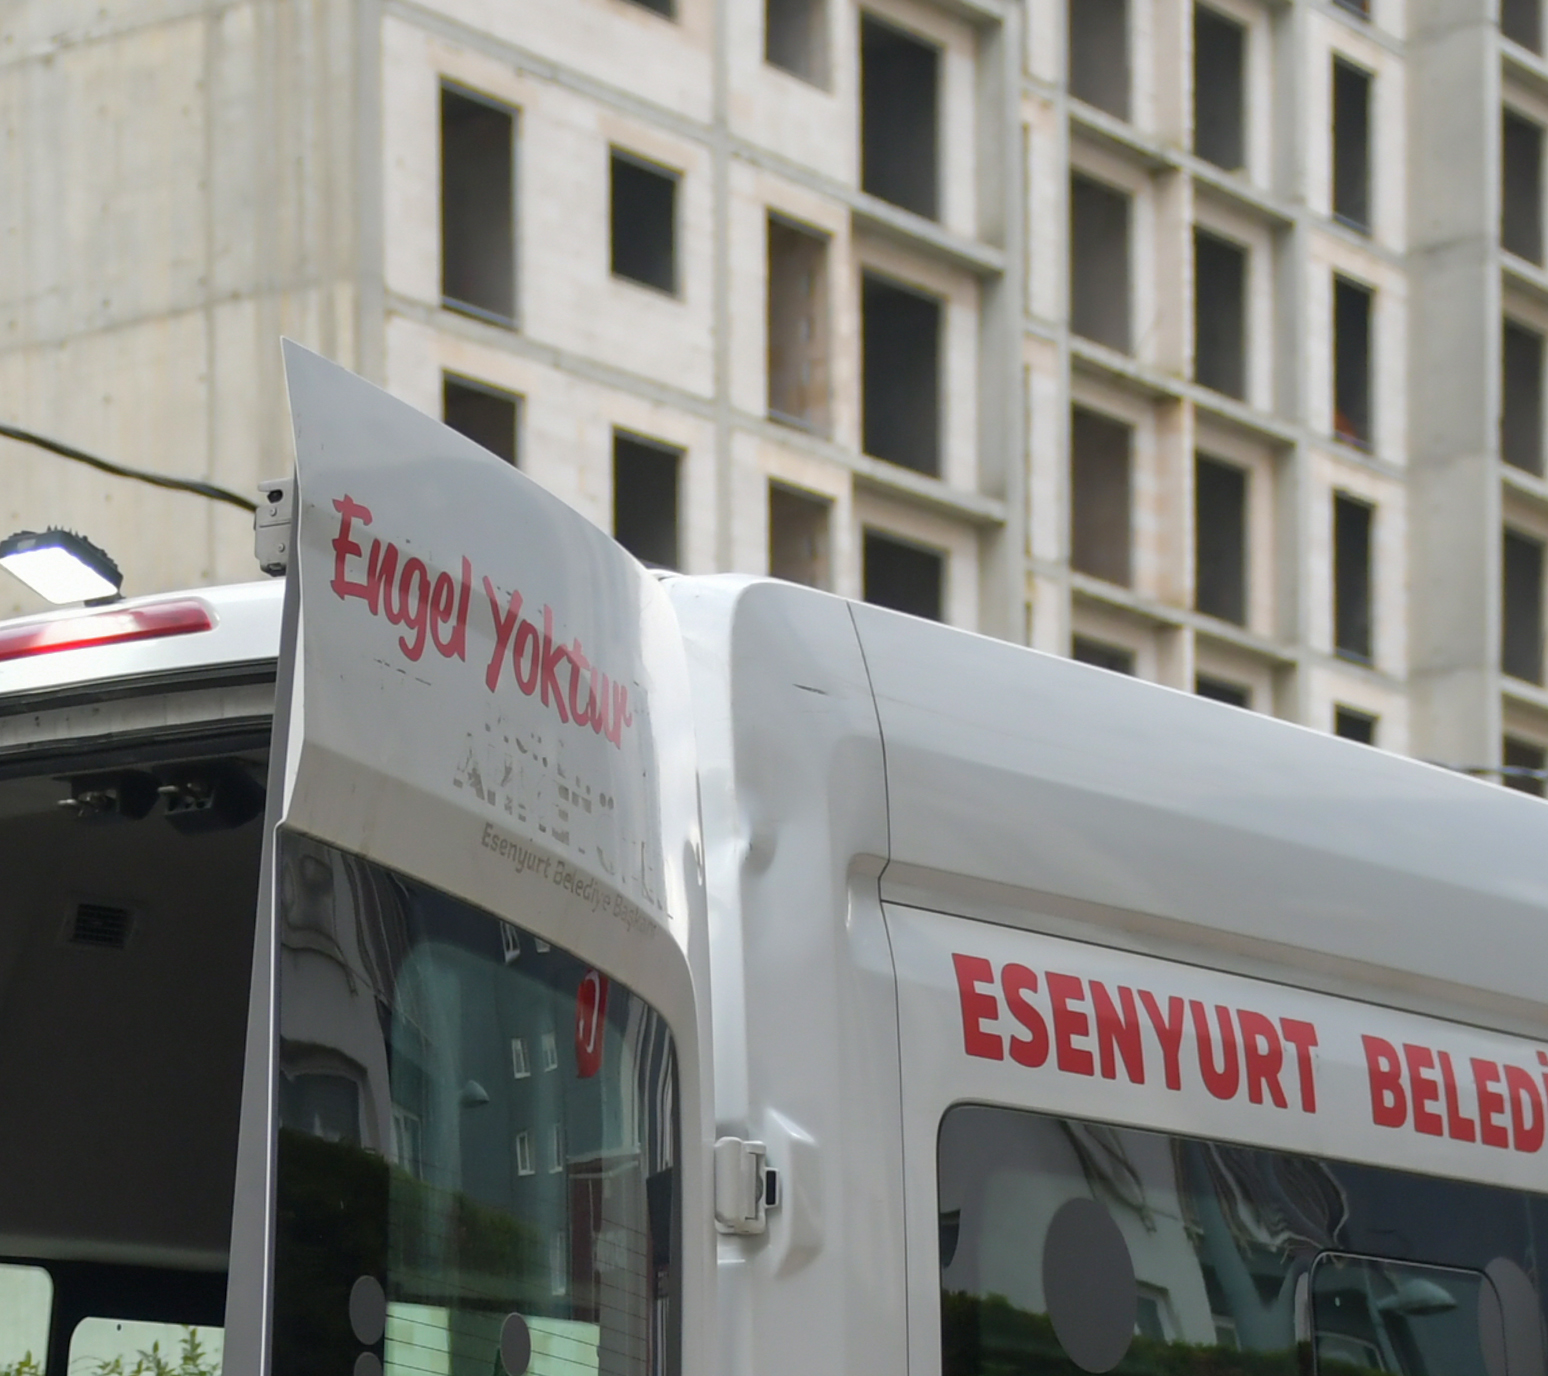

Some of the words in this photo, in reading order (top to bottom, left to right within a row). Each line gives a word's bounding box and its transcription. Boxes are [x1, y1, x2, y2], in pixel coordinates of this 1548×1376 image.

[329, 494, 471, 661] Engel
[484, 576, 632, 749] Yoktur
[481, 822, 552, 878] Esenyurt
[553, 860, 612, 914] Belediye
[952, 952, 1319, 1114] ESENYURT
